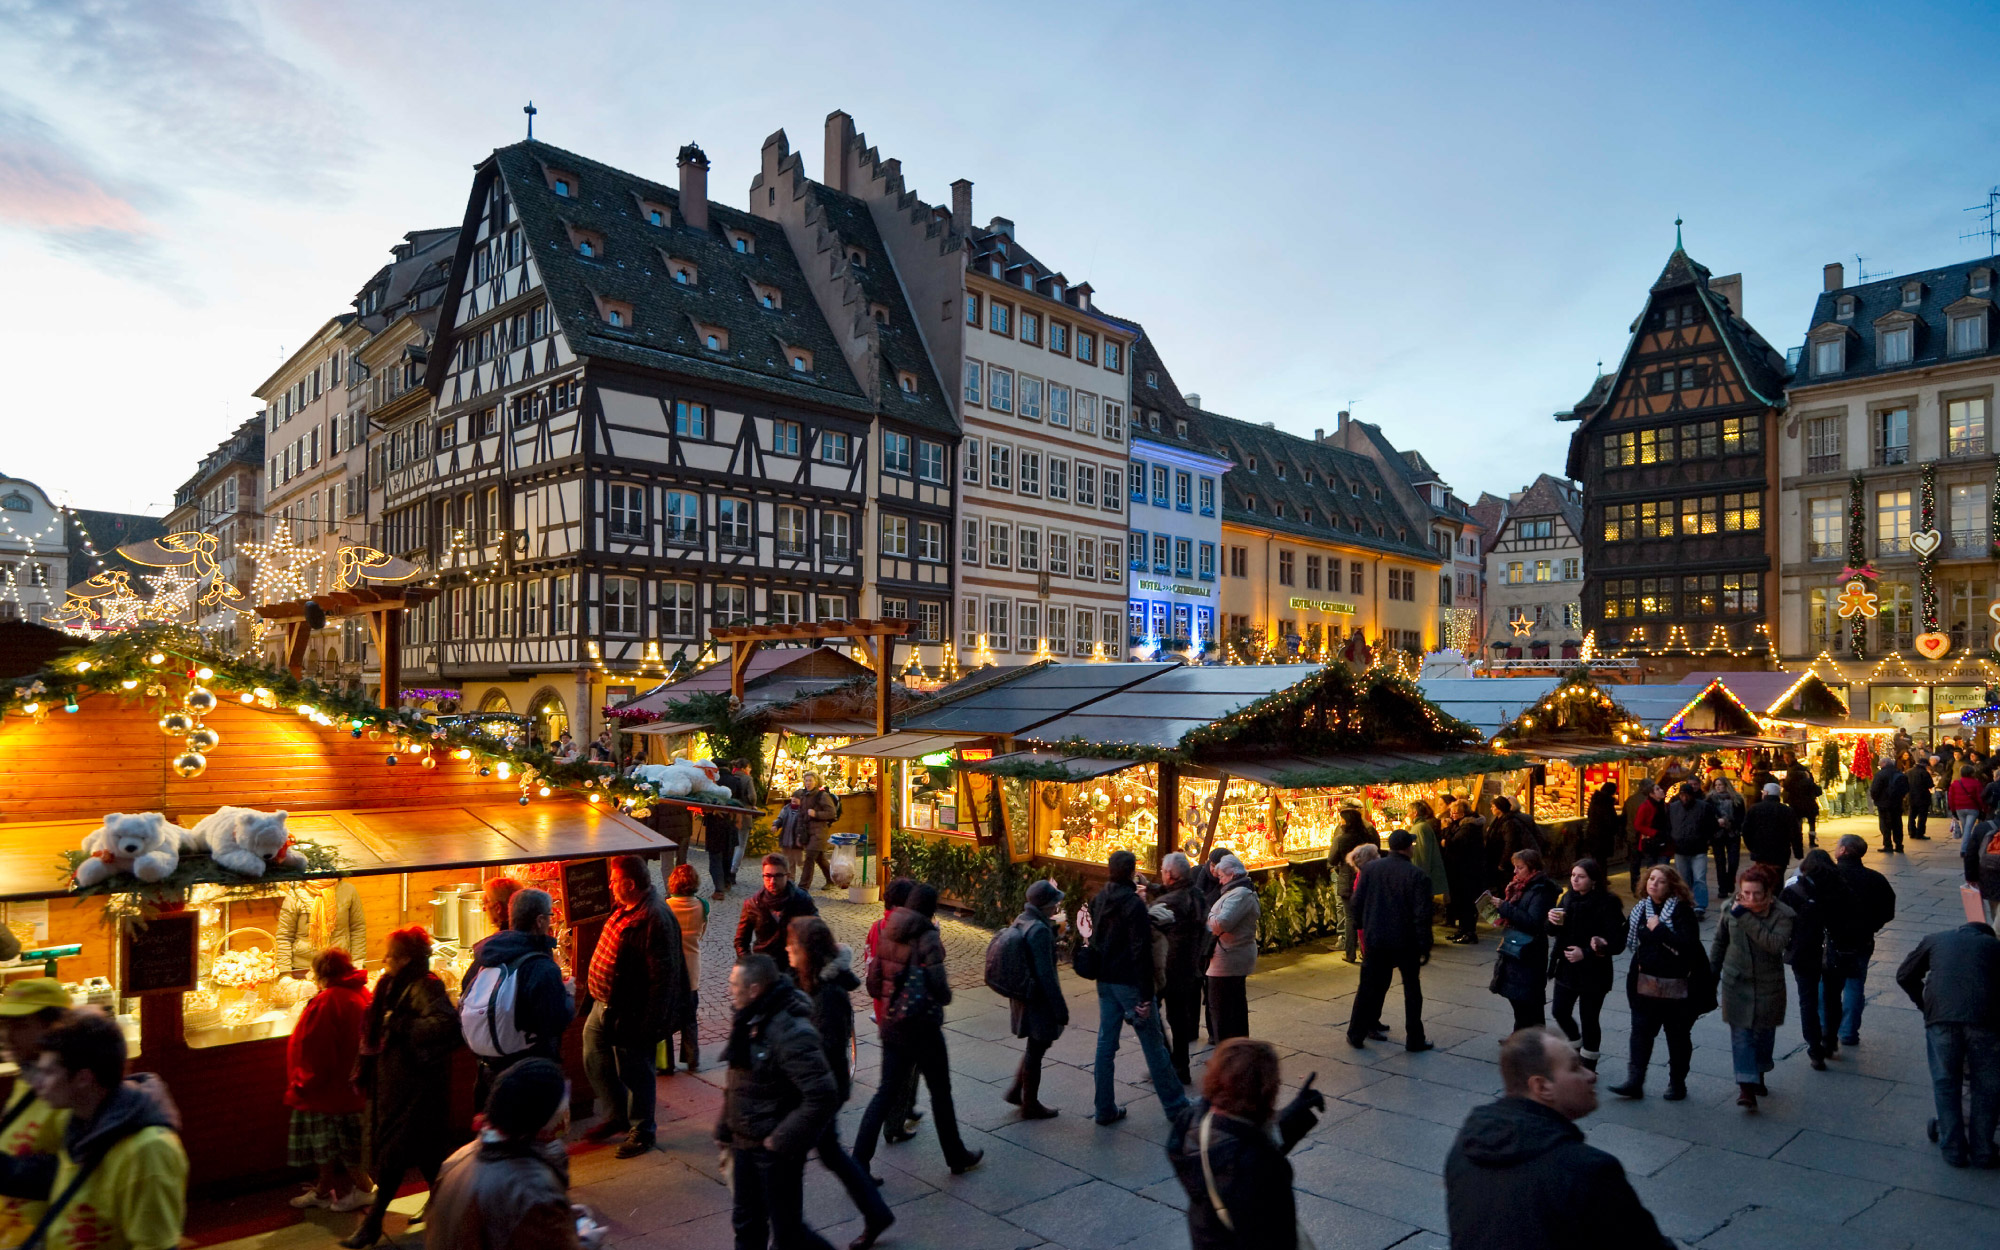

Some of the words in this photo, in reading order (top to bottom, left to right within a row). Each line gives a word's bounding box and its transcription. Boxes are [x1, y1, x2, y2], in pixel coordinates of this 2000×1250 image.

[1139, 579, 1162, 592] HOTEL
[1290, 597, 1310, 610] HOTEL
[1872, 668, 1909, 678] OFFICE
[1916, 668, 1928, 677] DE
[1936, 668, 1994, 677] TOURISME
